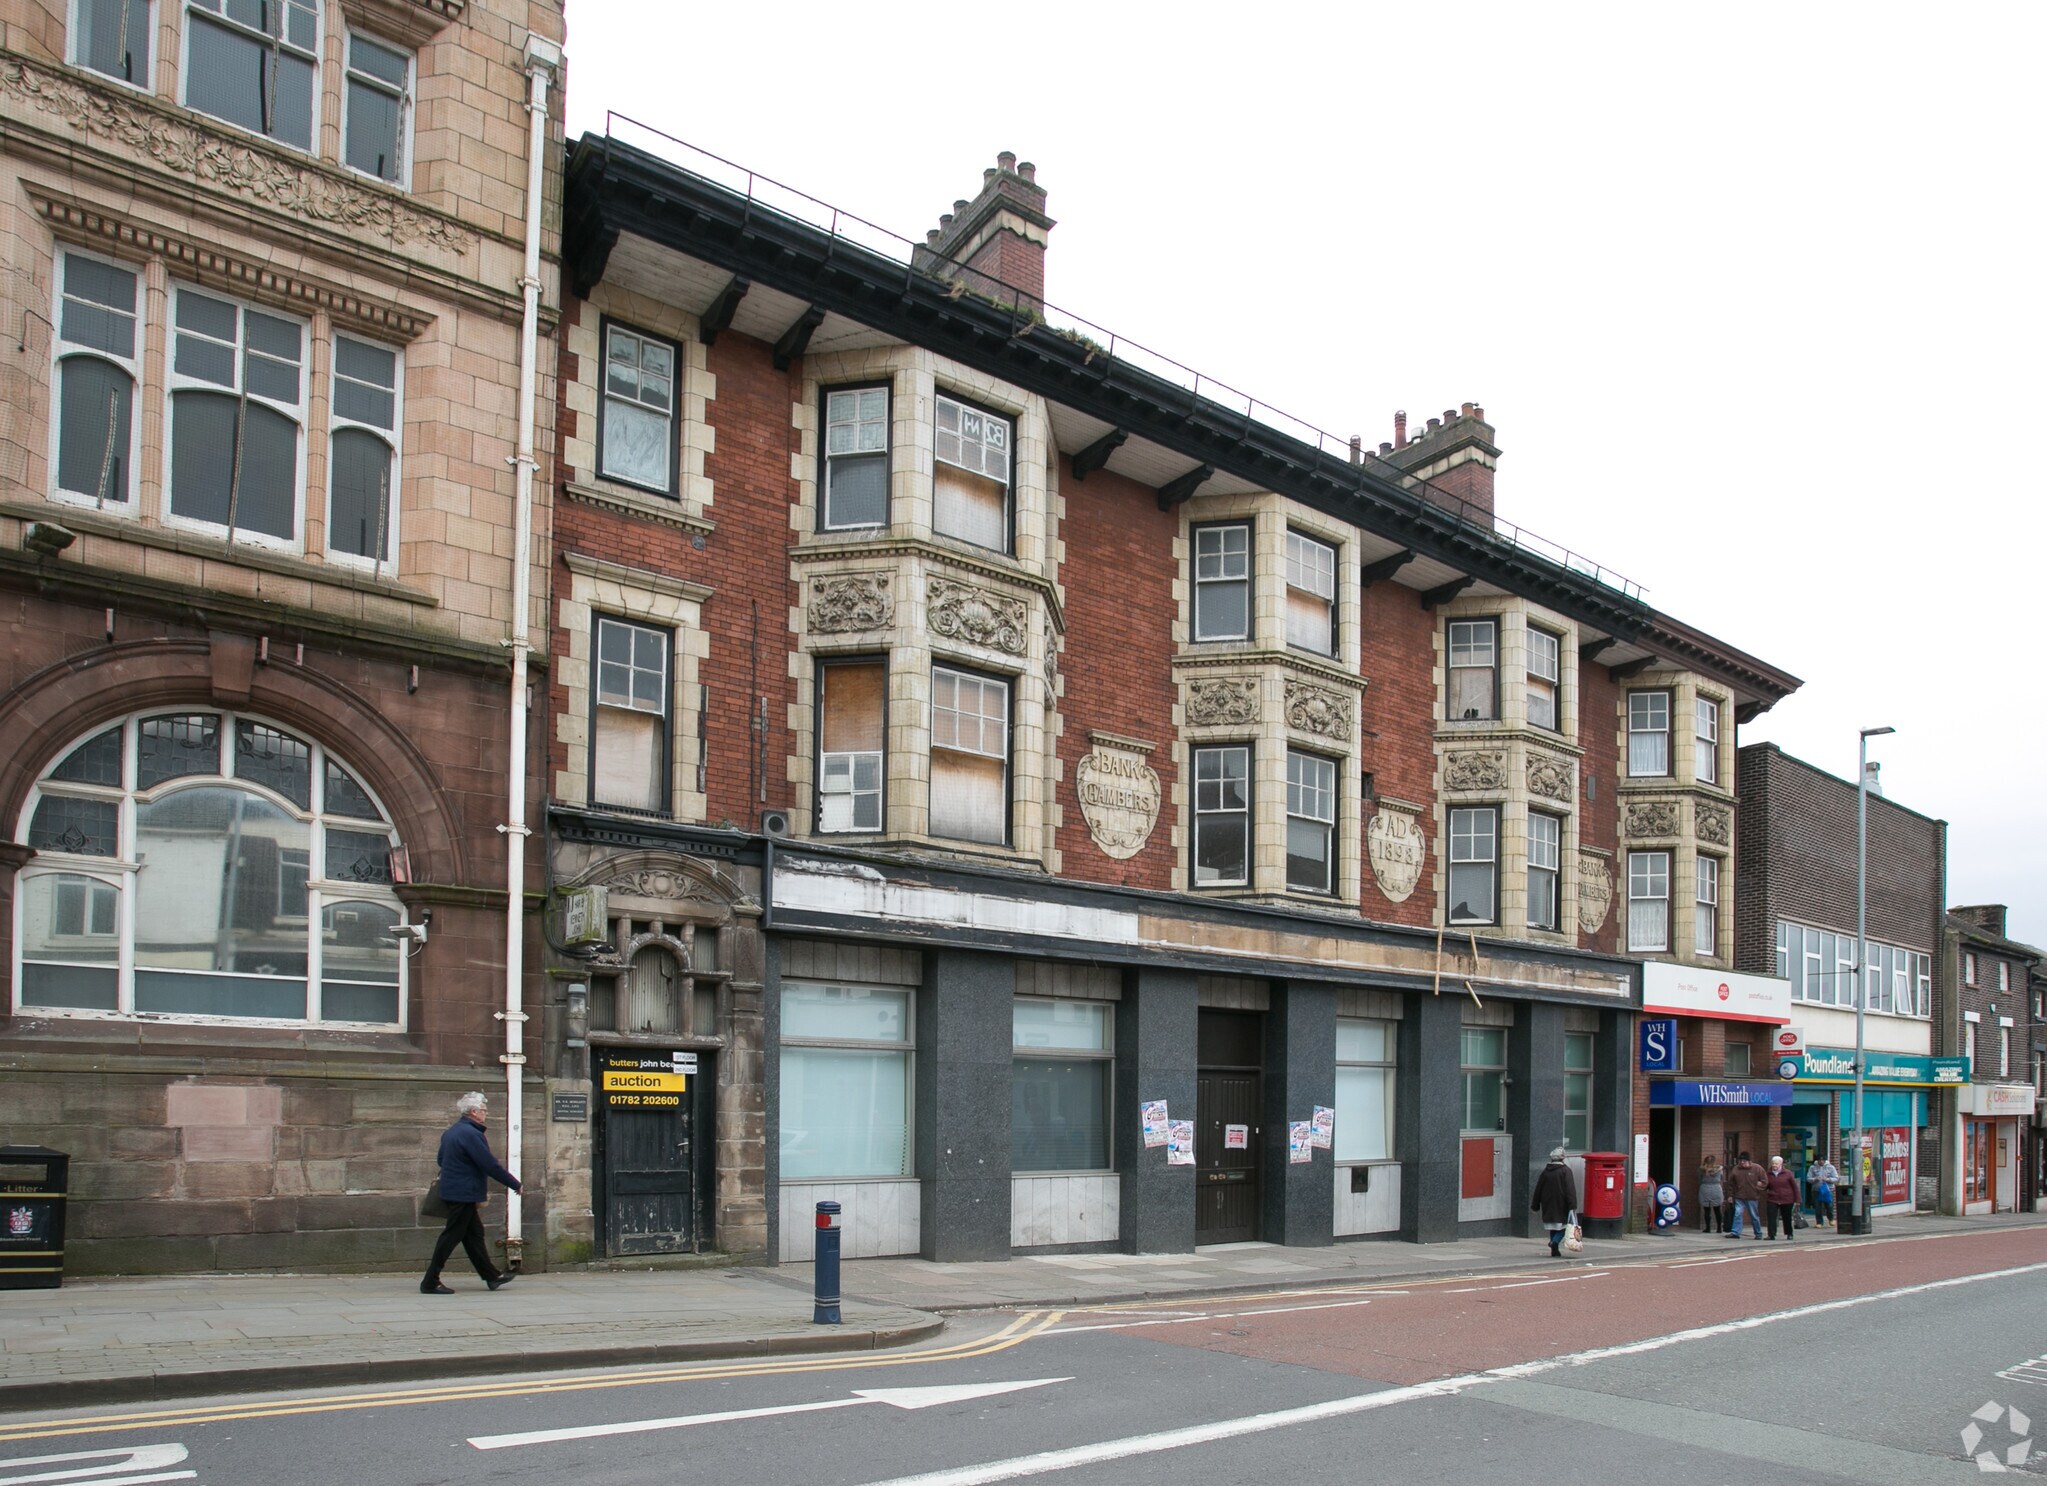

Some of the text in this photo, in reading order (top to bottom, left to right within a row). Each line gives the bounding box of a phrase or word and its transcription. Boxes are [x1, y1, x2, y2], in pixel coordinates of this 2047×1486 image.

[1099, 752, 1139, 780] BANK
[1386, 815, 1406, 839] AD
[1647, 1023, 1666, 1032] WH
[1646, 1032, 1666, 1062] S
[610, 1059, 675, 1068] butters john bee
[1804, 1053, 1855, 1074] Poundland
[610, 1075, 661, 1087] auction
[610, 1095, 679, 1105] 01782 202600
[1699, 1084, 1773, 1103] WHSmith LOCAL
[1994, 1090, 2009, 1103] CASH
[1883, 1142, 1909, 1158] BRANDS!
[1885, 1169, 1906, 1186] TODAY!
